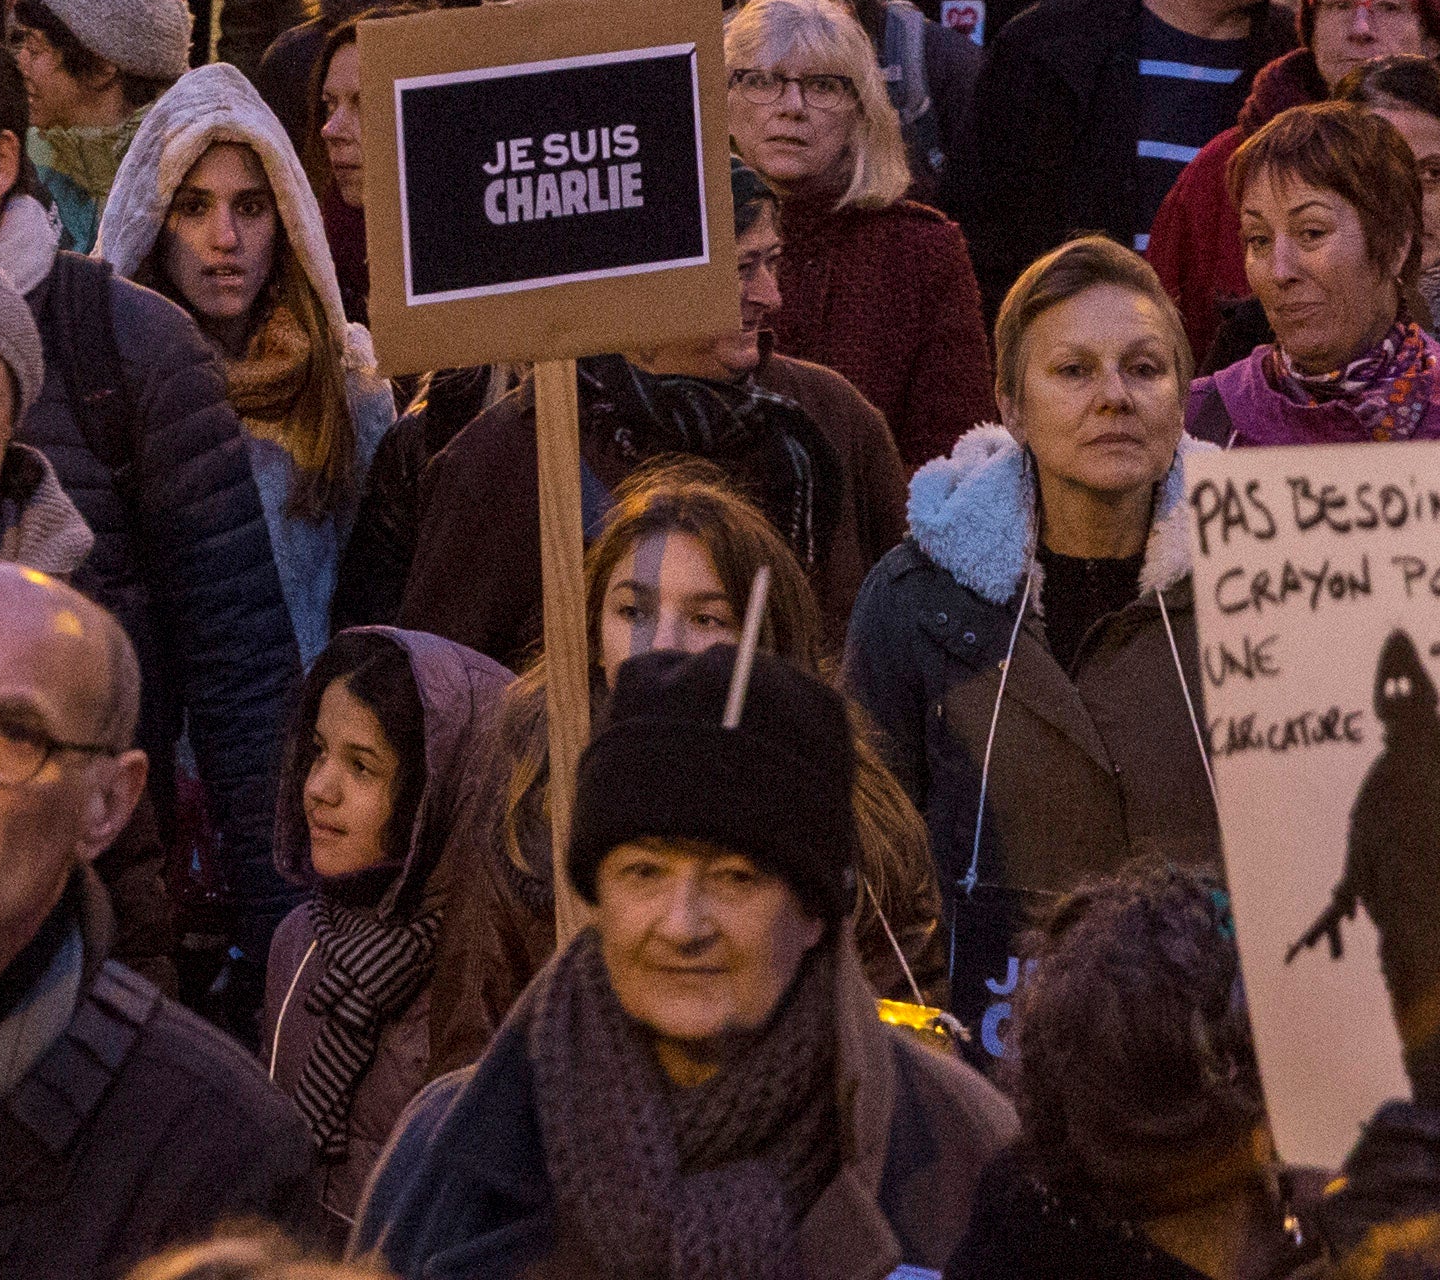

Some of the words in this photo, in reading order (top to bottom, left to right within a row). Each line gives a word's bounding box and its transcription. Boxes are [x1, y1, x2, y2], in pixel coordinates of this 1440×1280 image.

[482, 136, 536, 175] JE
[542, 123, 640, 166] SUIS
[484, 162, 644, 225] CHARLIE
[1189, 477, 1277, 557] PAS
[1215, 553, 1372, 615] CRAYON
[1204, 635, 1281, 687] UNE
